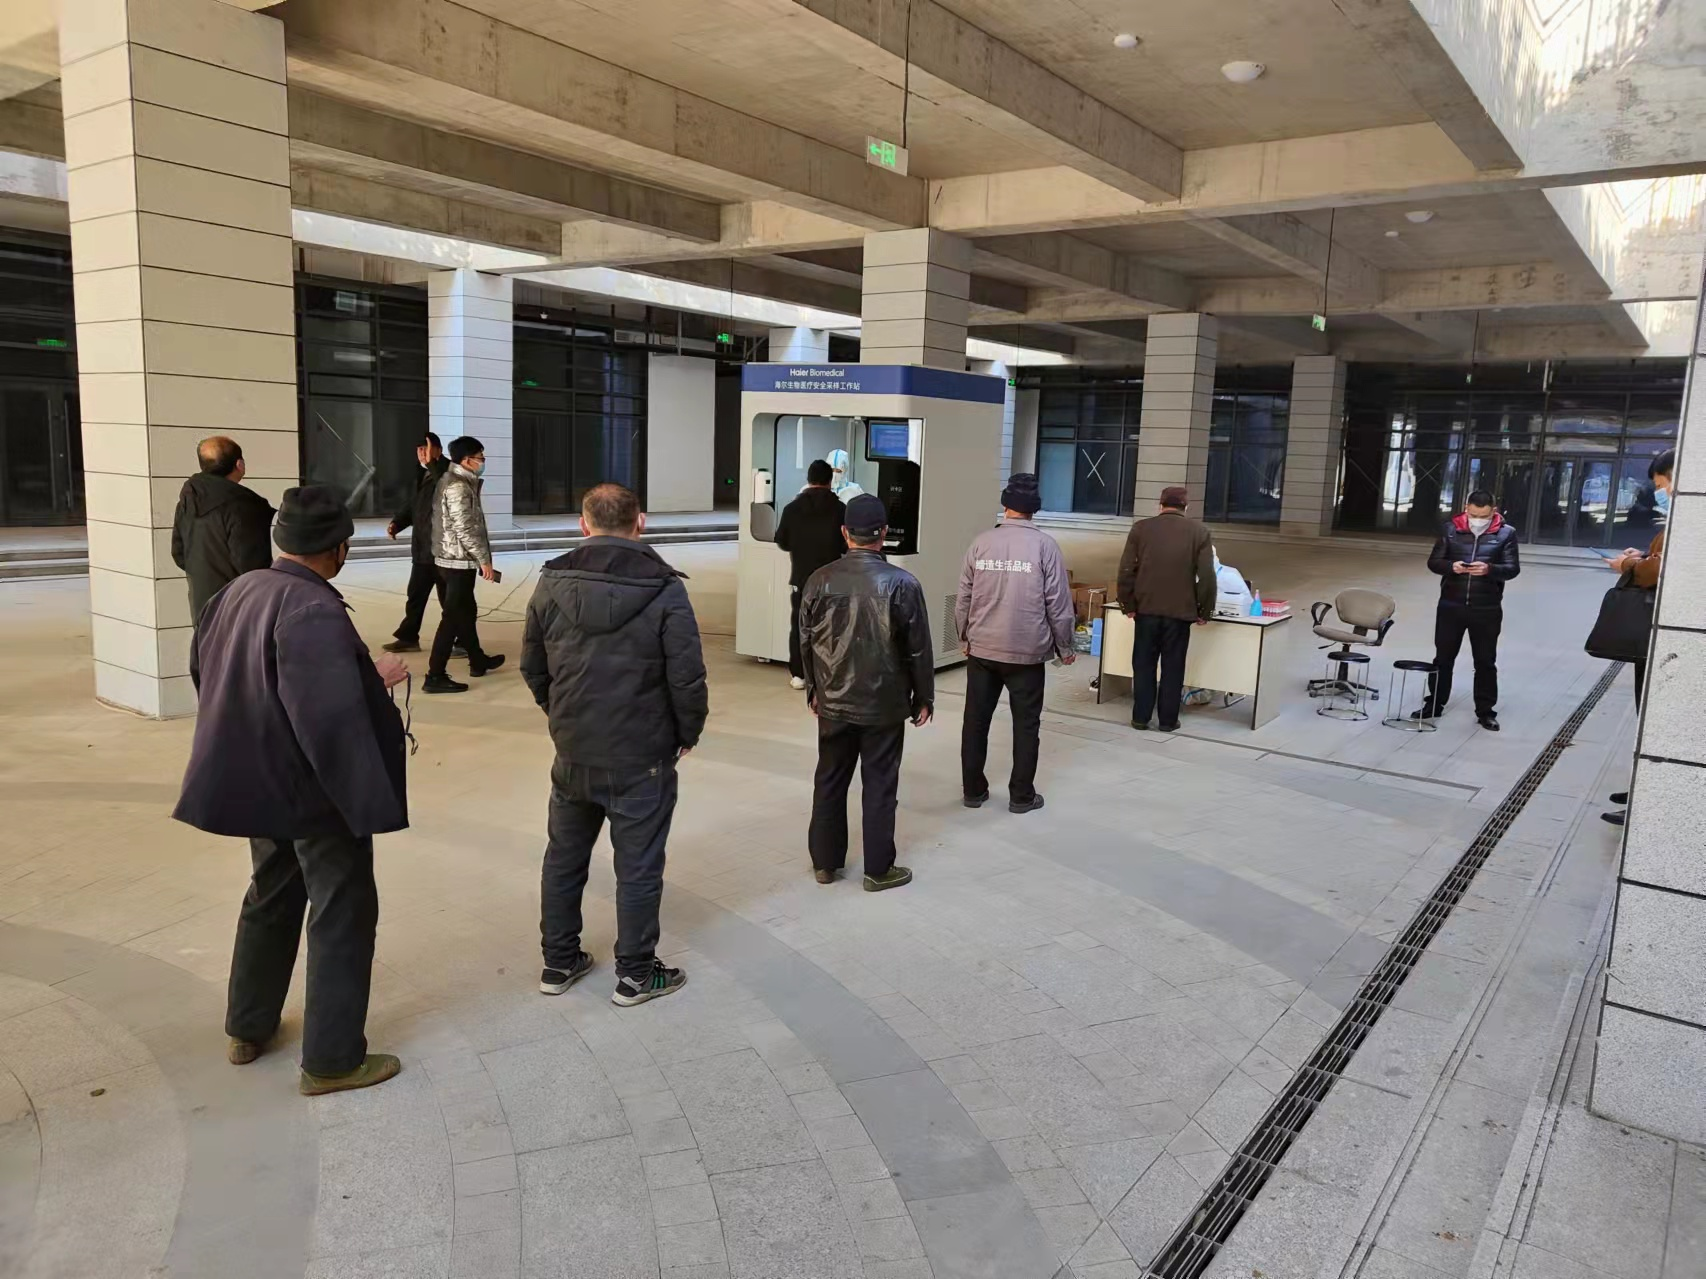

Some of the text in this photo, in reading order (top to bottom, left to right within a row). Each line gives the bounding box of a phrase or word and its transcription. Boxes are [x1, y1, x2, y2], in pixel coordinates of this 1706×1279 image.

[790, 368, 845, 377] Haier Biomedical
[774, 380, 861, 391] 海尔生物医疗安全采样工作站
